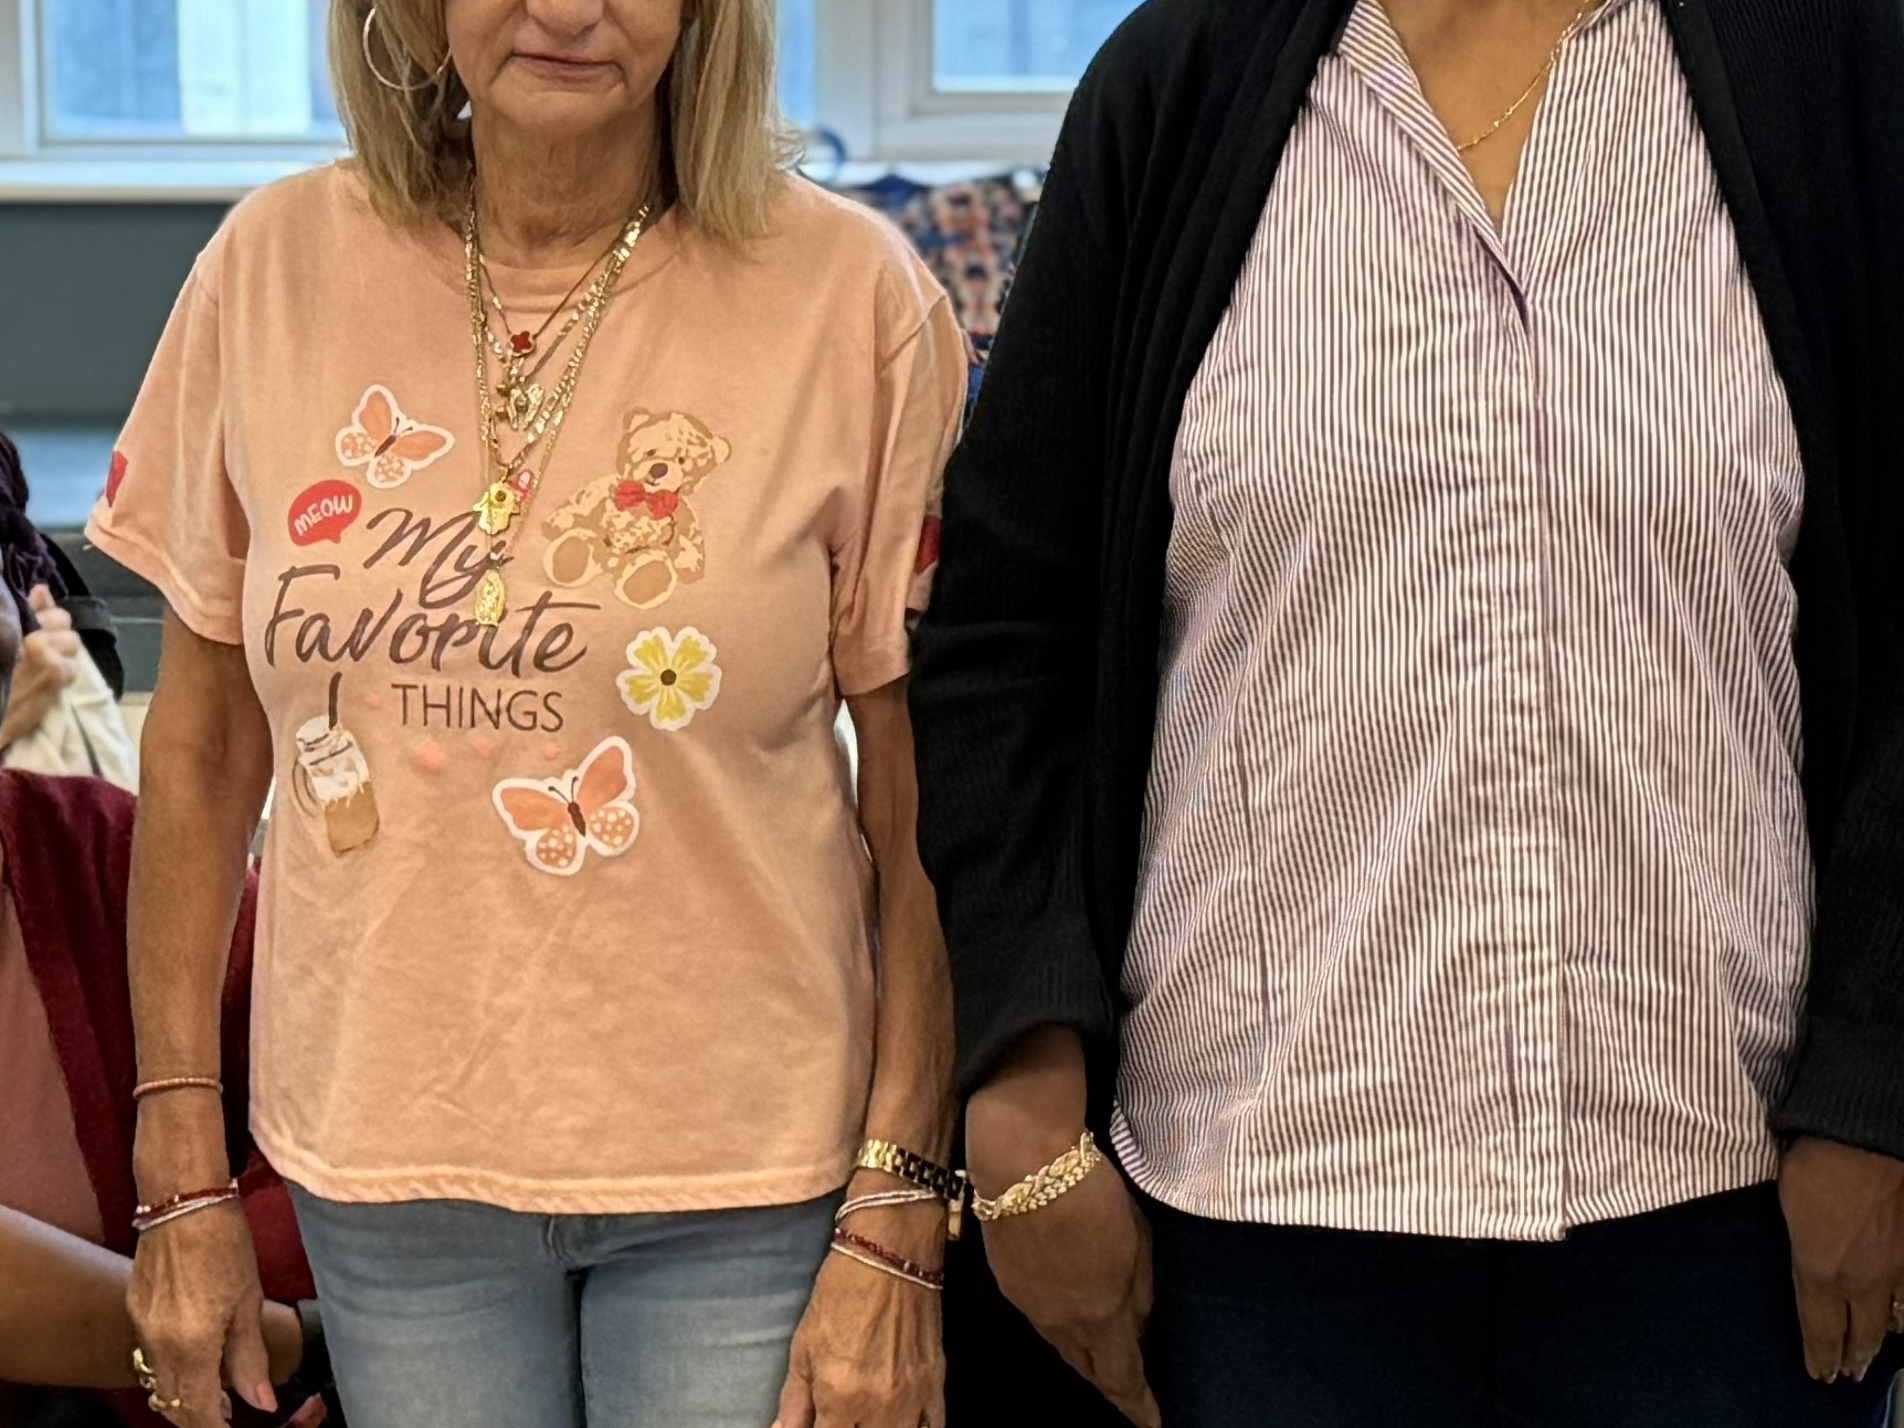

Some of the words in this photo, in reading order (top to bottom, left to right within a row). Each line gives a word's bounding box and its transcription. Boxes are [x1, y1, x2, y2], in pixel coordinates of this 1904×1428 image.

[293, 493, 354, 537] MEOW
[362, 507, 514, 610] My
[264, 563, 602, 679] Favorite
[390, 683, 564, 733] THINGS
